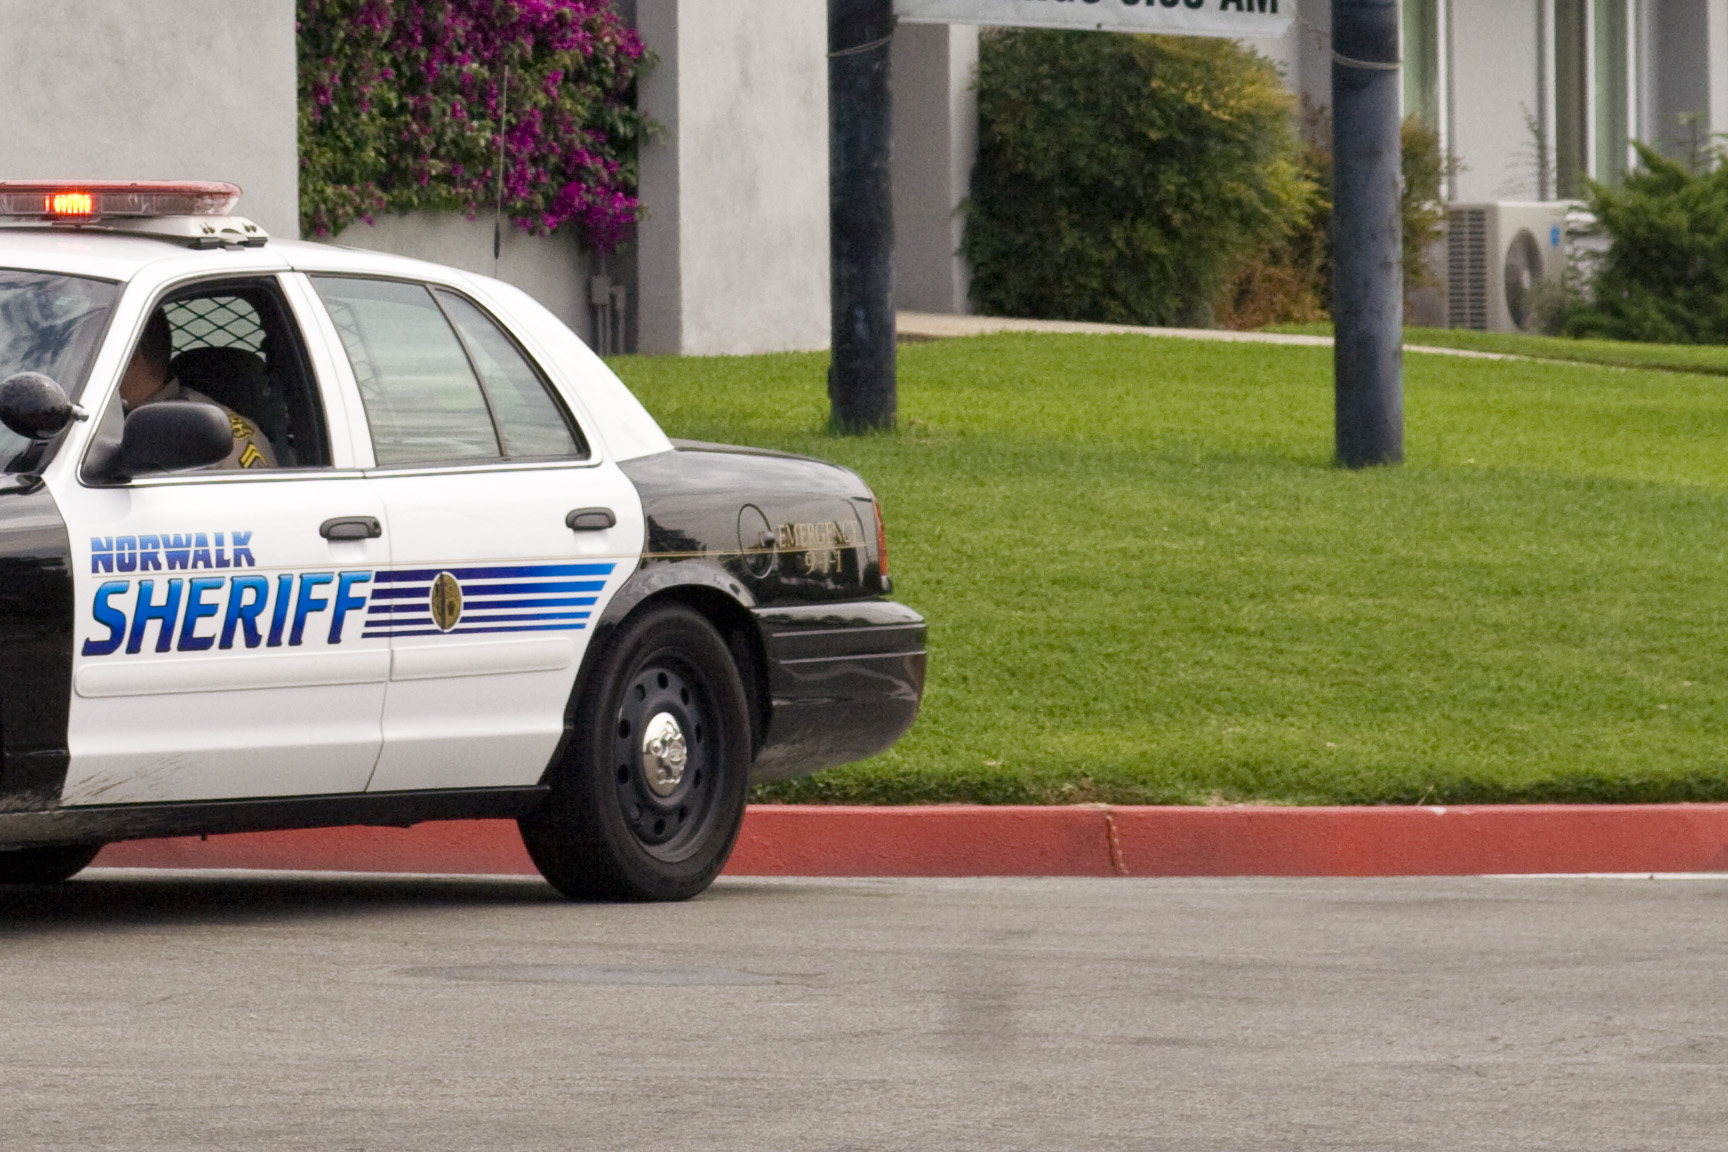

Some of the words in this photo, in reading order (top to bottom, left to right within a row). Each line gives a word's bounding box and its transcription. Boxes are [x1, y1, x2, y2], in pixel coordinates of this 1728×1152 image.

[90, 531, 256, 574] NORWALK
[778, 520, 858, 547] EMERGENCY
[81, 570, 373, 657] SHERIFF
